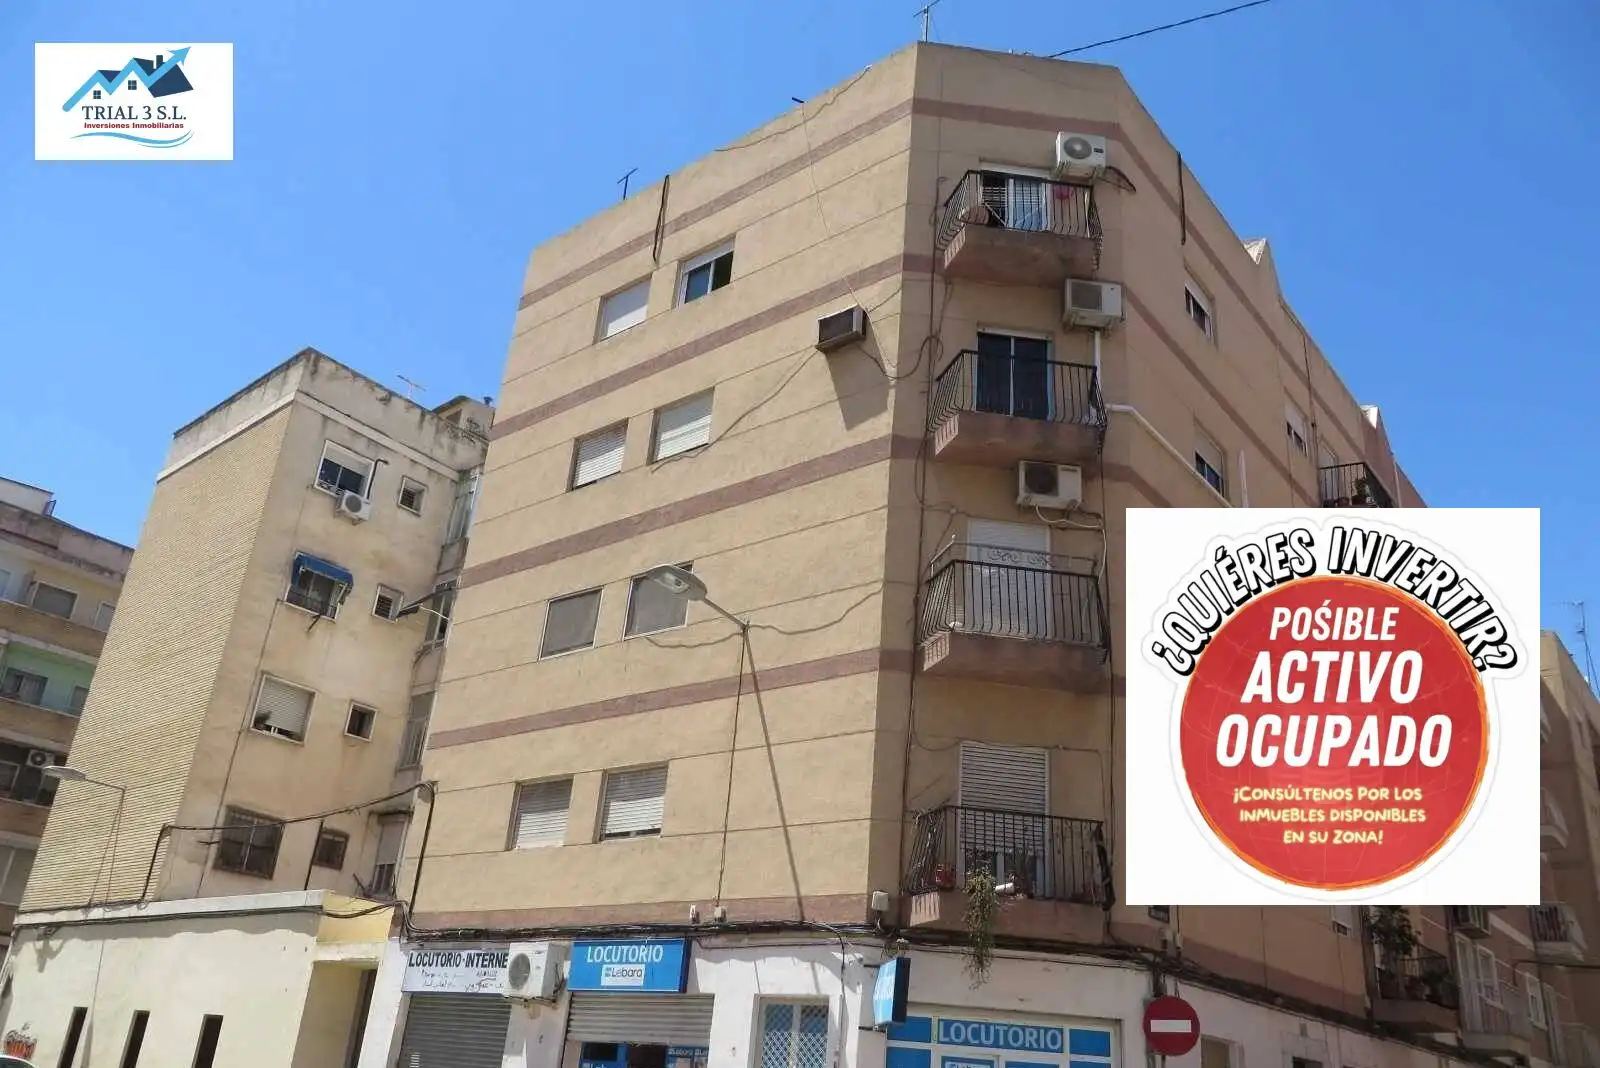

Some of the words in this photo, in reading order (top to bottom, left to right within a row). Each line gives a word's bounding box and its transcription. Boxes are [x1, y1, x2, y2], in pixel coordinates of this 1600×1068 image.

[465, 952, 510, 968] INTERNE
[586, 945, 664, 963] LOCUTORIO
[939, 1021, 1062, 1050] LOCUTORIO
